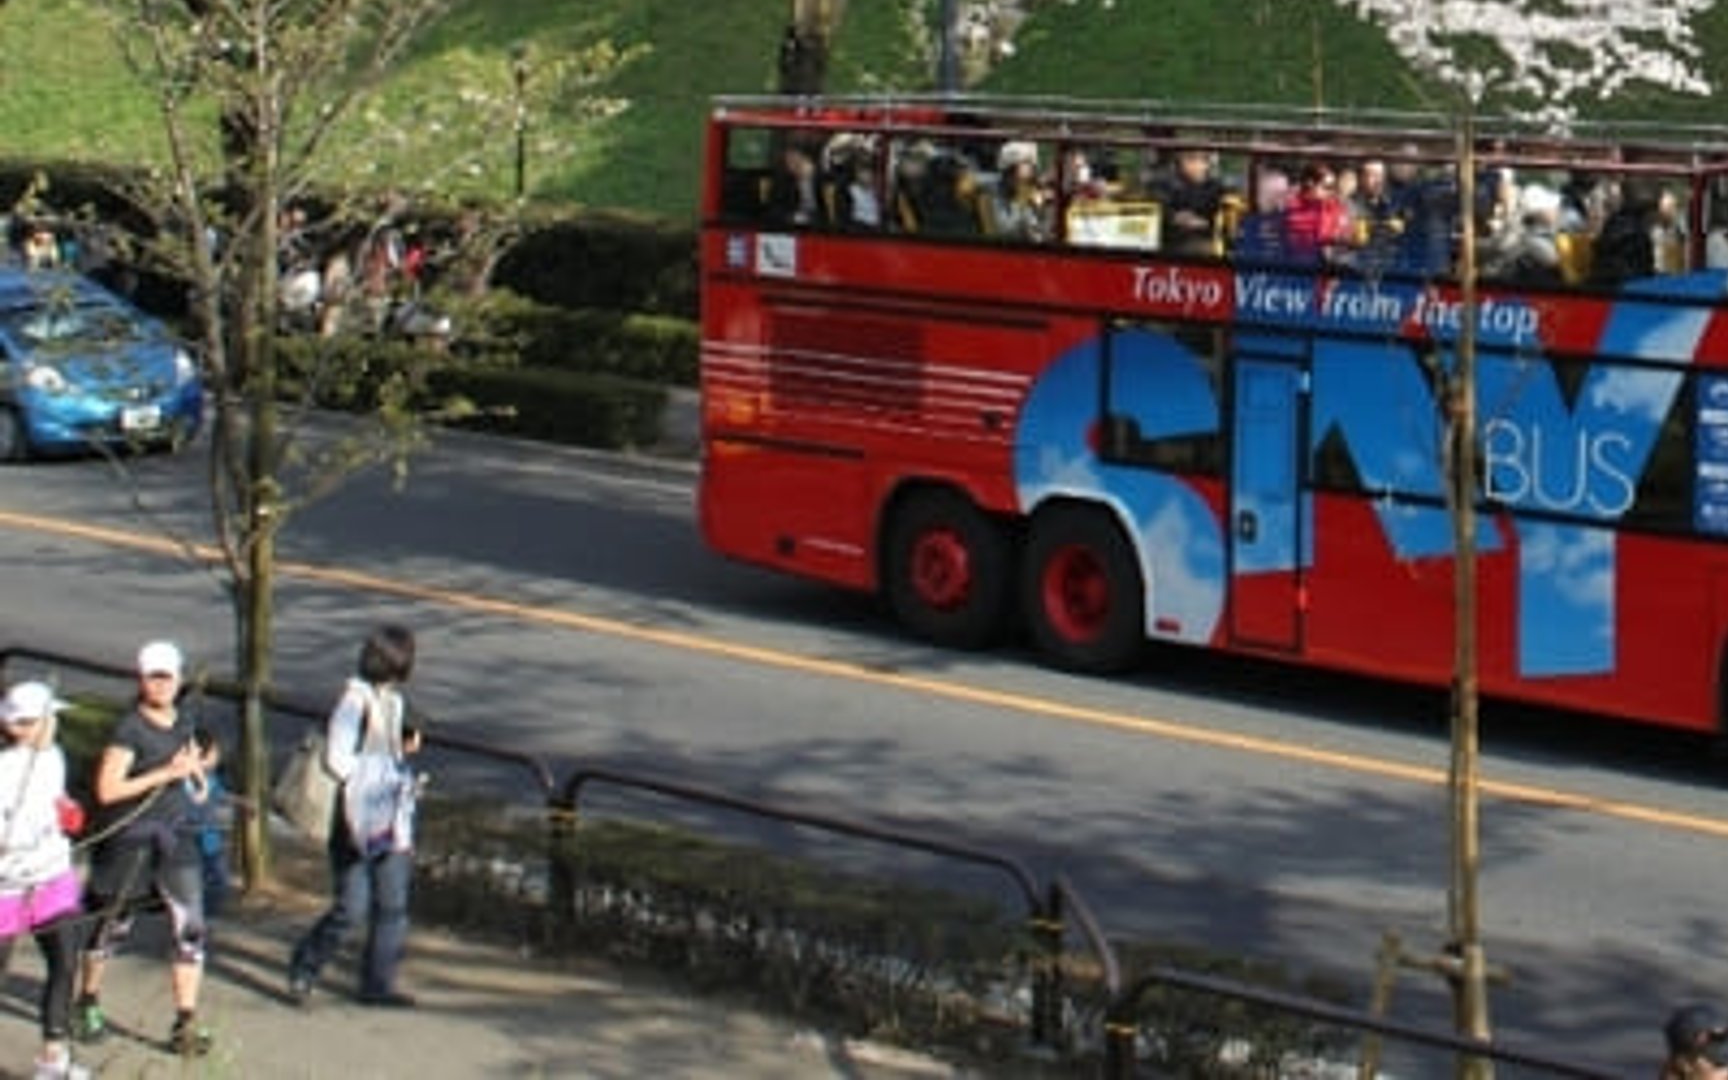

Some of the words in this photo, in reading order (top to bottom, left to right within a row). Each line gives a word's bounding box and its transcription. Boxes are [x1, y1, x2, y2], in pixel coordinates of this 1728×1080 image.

[1132, 267, 1223, 319] Tokyo
[1235, 272, 1310, 314] View
[1319, 277, 1402, 323] from
[1480, 296, 1540, 343] top
[1485, 418, 1635, 518] BUS
